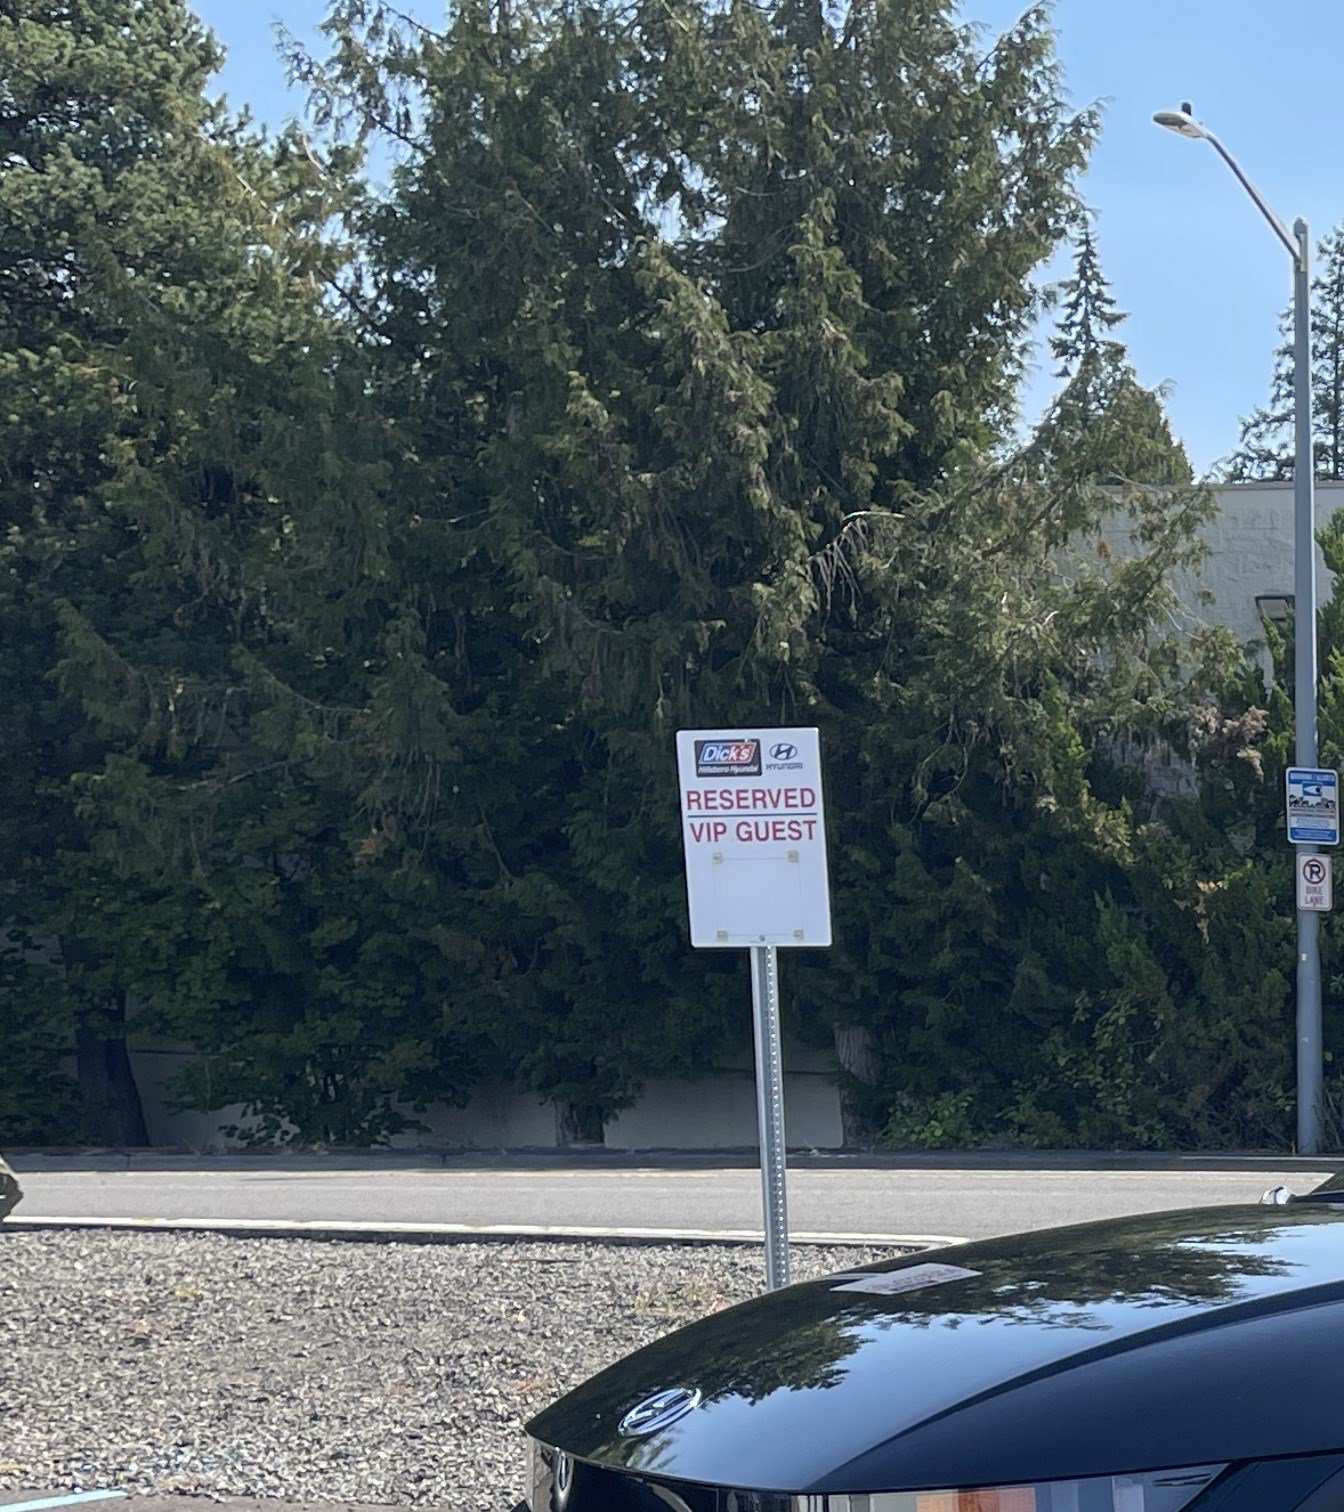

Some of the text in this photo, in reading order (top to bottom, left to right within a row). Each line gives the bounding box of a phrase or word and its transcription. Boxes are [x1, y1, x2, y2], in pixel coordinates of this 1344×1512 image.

[686, 787, 816, 811] RESERVED
[689, 819, 817, 843] VIP GUEST
